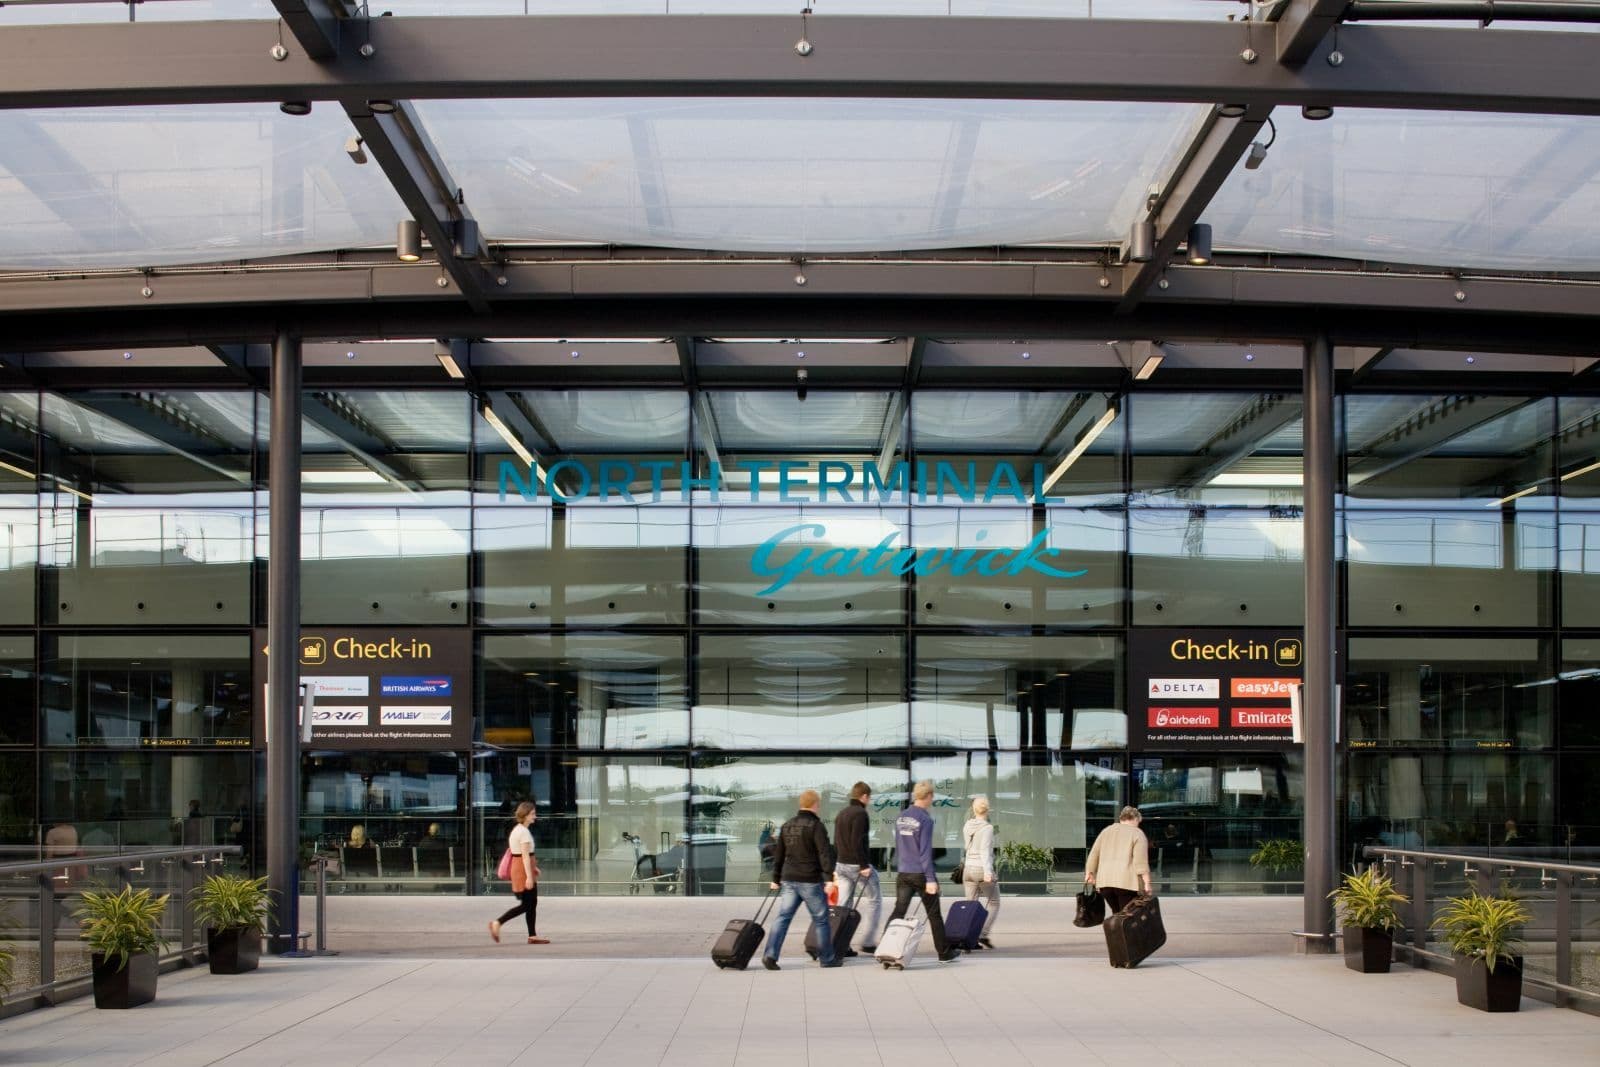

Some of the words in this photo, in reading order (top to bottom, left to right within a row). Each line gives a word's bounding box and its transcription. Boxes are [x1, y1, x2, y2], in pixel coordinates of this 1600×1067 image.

[498, 460, 719, 504] NORTH
[735, 460, 1065, 504] TERMINAL
[751, 522, 1088, 597] Gatwick
[333, 637, 432, 659] Check-in
[1170, 638, 1269, 660] Check-in
[1164, 684, 1205, 692] DELTA
[1169, 714, 1211, 725] airberlin
[1196, 734, 1211, 742] please
[1239, 734, 1251, 742] flight
